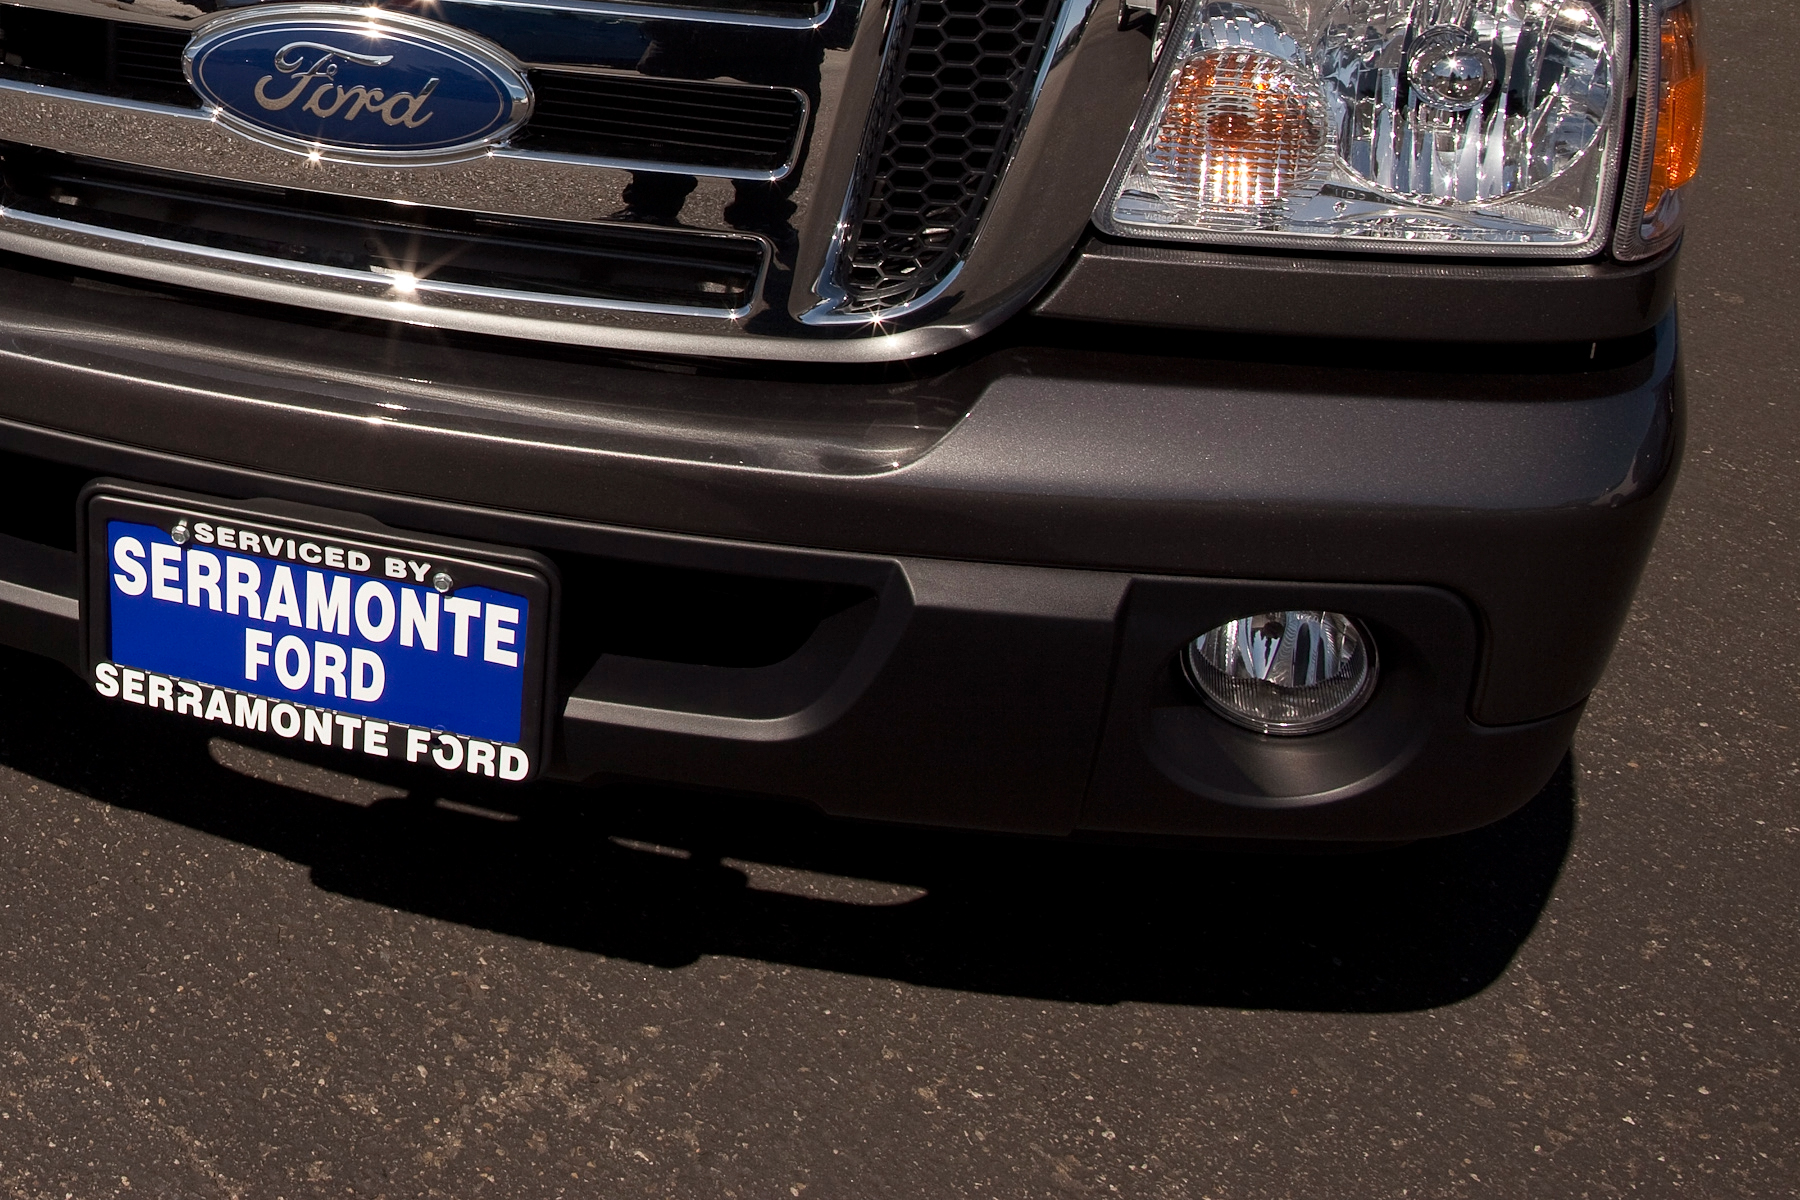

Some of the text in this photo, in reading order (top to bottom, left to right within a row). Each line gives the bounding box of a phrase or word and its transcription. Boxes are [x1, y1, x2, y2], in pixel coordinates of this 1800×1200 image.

[254, 41, 440, 129] Ford
[194, 522, 432, 583] SERVICED BY
[113, 536, 520, 668] SERRAMONTE
[245, 628, 386, 704] FORD
[95, 662, 530, 782] SERRAMONTE FORD
